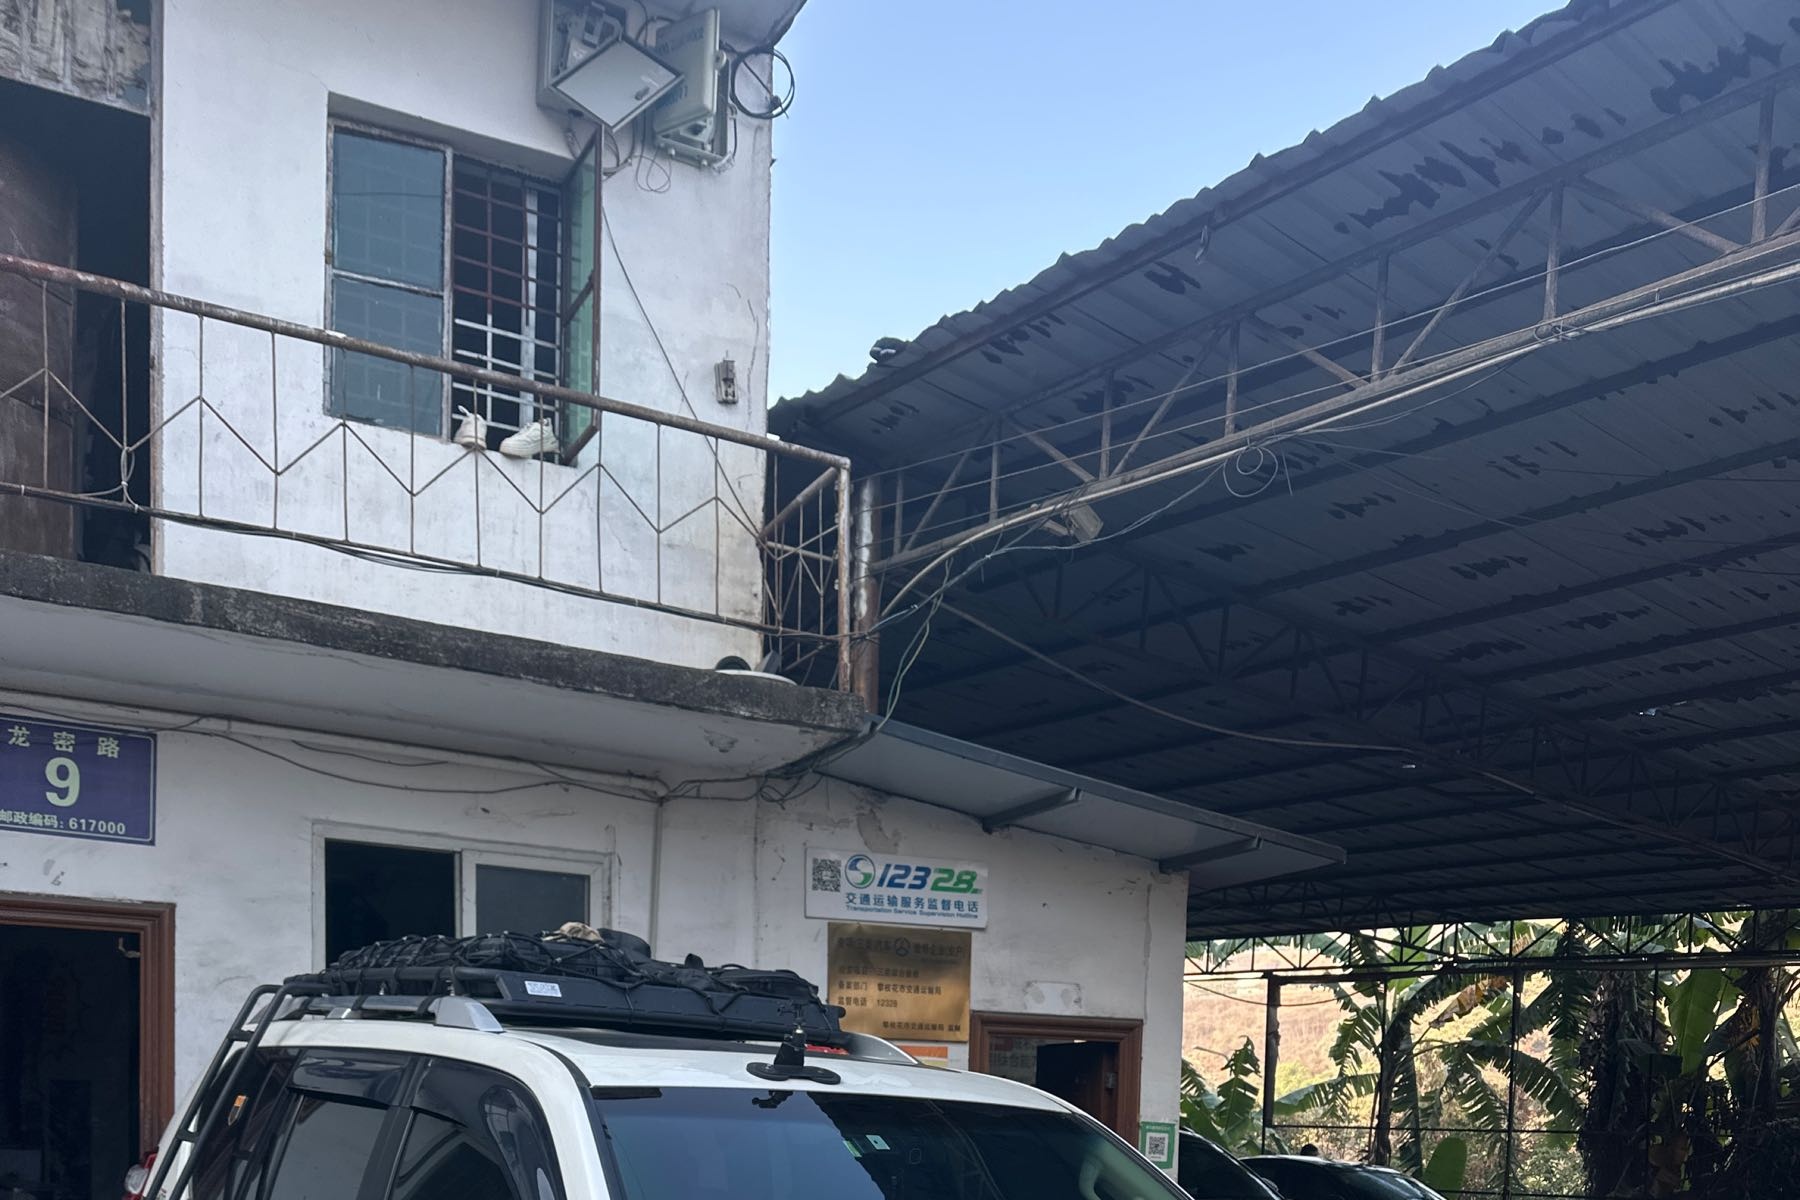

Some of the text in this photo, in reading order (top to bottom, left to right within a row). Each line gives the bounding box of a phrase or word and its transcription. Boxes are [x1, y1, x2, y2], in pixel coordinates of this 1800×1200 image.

[8, 725, 120, 758] 龙密路
[45, 757, 81, 807] 9
[68, 817, 126, 835] 617000
[846, 892, 979, 913] 交通运输服务监督电话
